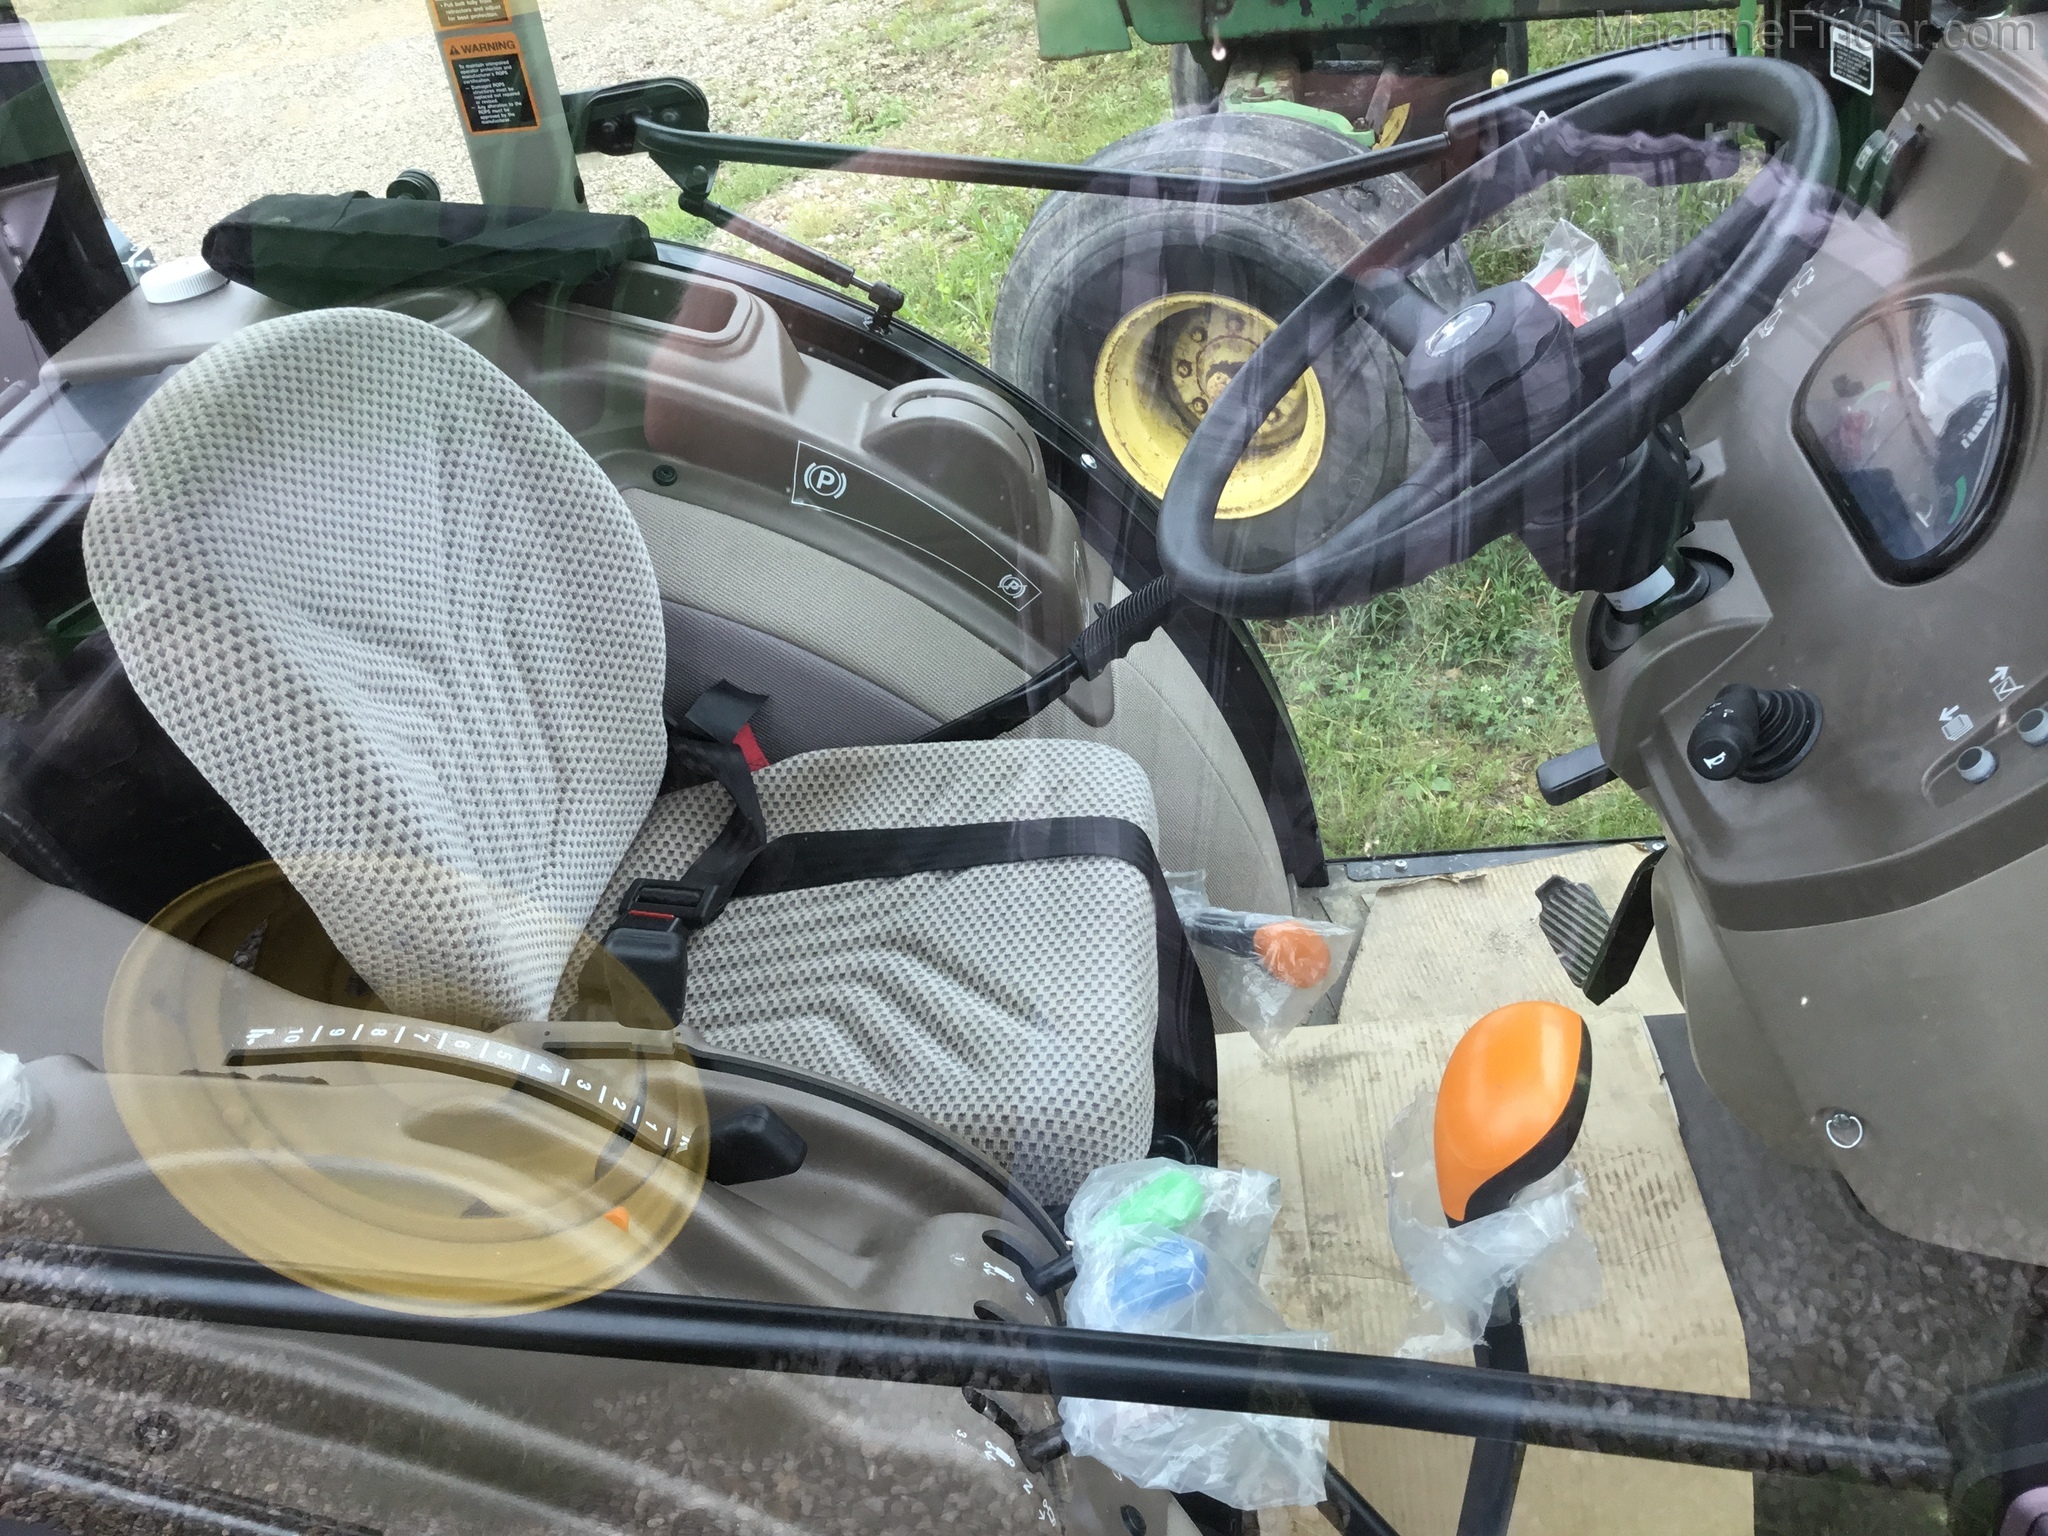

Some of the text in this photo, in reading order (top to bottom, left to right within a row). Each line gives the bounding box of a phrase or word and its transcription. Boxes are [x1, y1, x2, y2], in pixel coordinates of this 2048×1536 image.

[460, 40, 516, 54] WARNING
[284, 1028, 304, 1043] 10
[329, 1028, 345, 1037] 9
[370, 1028, 387, 1037] 8
[414, 1033, 430, 1042] 7
[454, 1040, 471, 1050] 6
[497, 1050, 513, 1061] 5
[536, 1062, 553, 1074] 4
[576, 1079, 592, 1091] 3
[612, 1096, 627, 1111] 2
[645, 1120, 658, 1131] 1
[957, 1429, 967, 1438] 3
[1023, 1478, 1033, 1494] N
